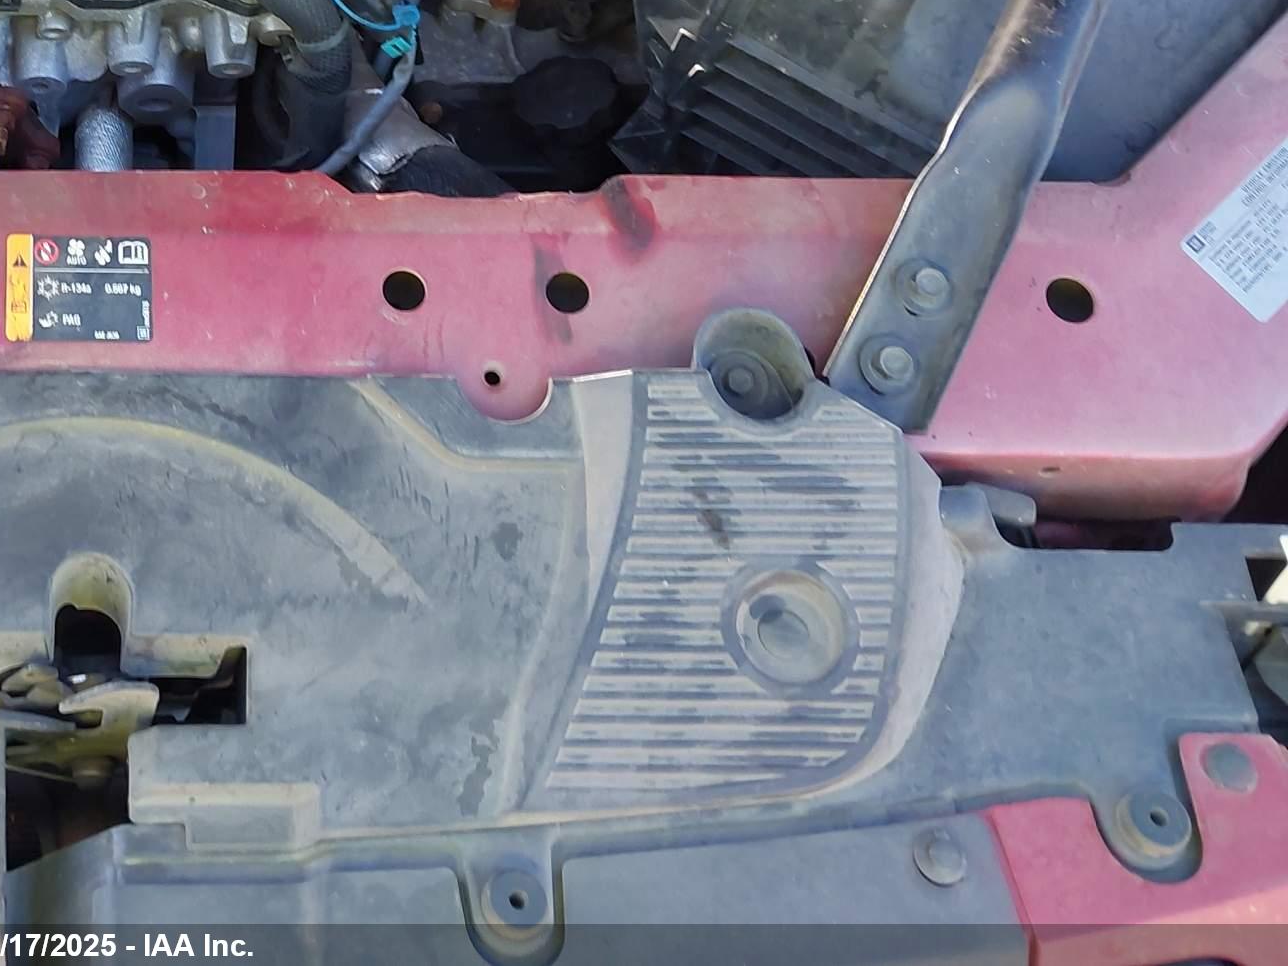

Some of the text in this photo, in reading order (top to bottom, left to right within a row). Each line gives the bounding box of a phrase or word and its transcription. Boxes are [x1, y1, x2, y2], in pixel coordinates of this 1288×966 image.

[67, 255, 87, 265] AUTO
[61, 283, 92, 294] R-134a
[129, 282, 142, 296] kg
